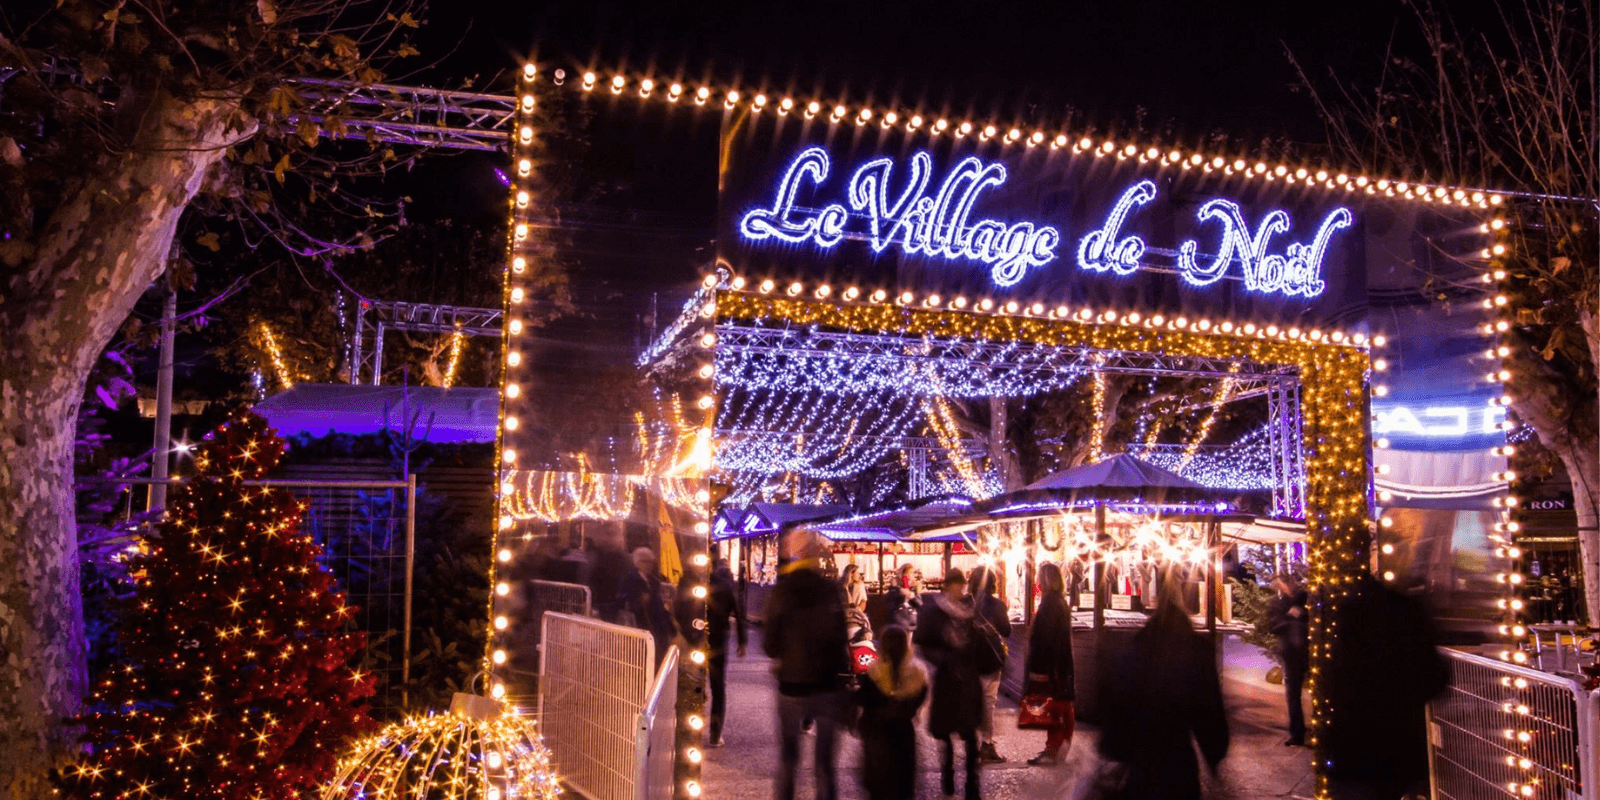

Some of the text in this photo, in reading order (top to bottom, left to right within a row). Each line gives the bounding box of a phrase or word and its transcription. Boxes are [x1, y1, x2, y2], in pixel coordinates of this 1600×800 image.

[741, 147, 1352, 296] Le Village de Noël
